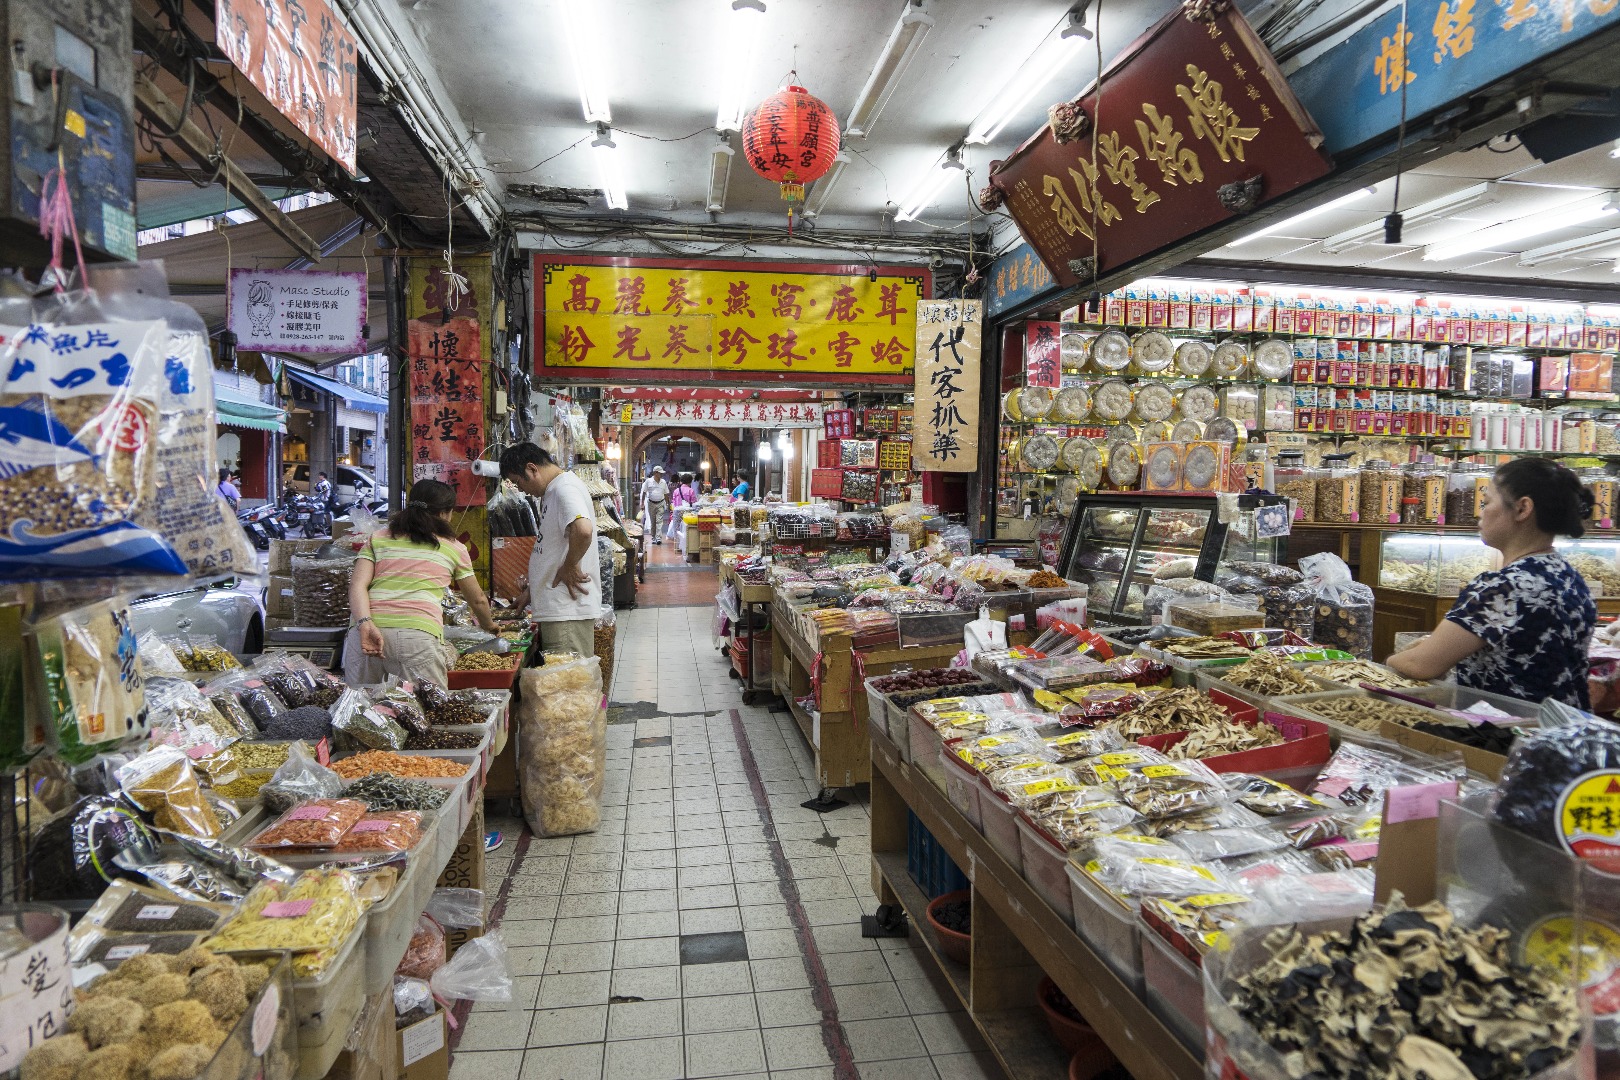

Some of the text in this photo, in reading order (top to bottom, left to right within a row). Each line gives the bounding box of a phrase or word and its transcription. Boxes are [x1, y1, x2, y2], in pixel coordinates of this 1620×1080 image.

[800, 111, 823, 167] 普願宮
[1042, 63, 1260, 240] 懷結堂公司
[312, 287, 349, 297] Studio
[286, 312, 321, 320] 嫁接睫毛
[924, 303, 977, 324] 懷結堂
[286, 322, 321, 332] 凝膠美甲
[429, 331, 466, 442] 懷結堂
[928, 328, 968, 462] 代客抓藥
[1569, 806, 1620, 832] 野生
